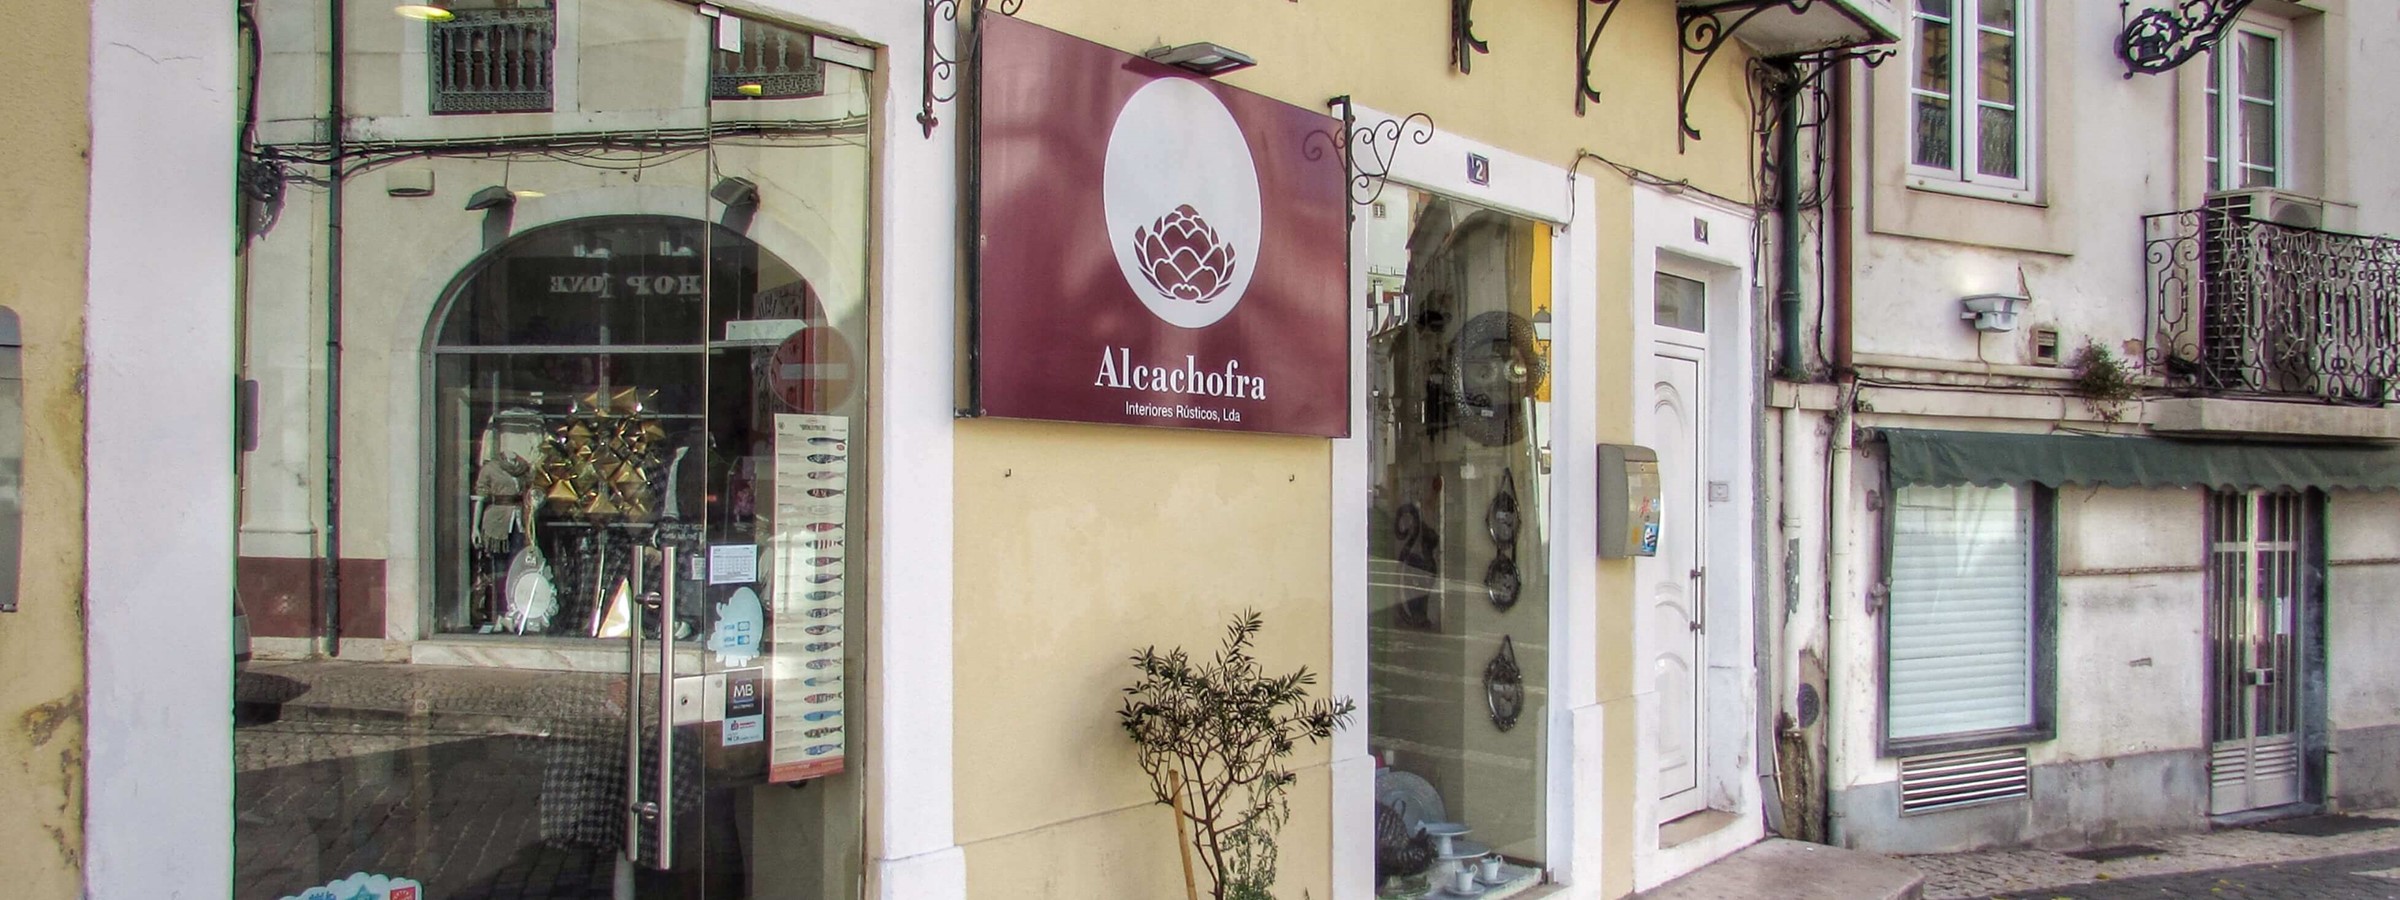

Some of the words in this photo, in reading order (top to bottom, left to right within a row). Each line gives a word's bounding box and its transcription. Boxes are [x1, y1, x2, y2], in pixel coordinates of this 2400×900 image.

[1094, 345, 1266, 400] Alcachofra
[1125, 401, 1173, 418] Interiores
[1176, 404, 1220, 422] Rústicos,
[1223, 408, 1240, 422] Lda
[734, 684, 754, 697] MB
